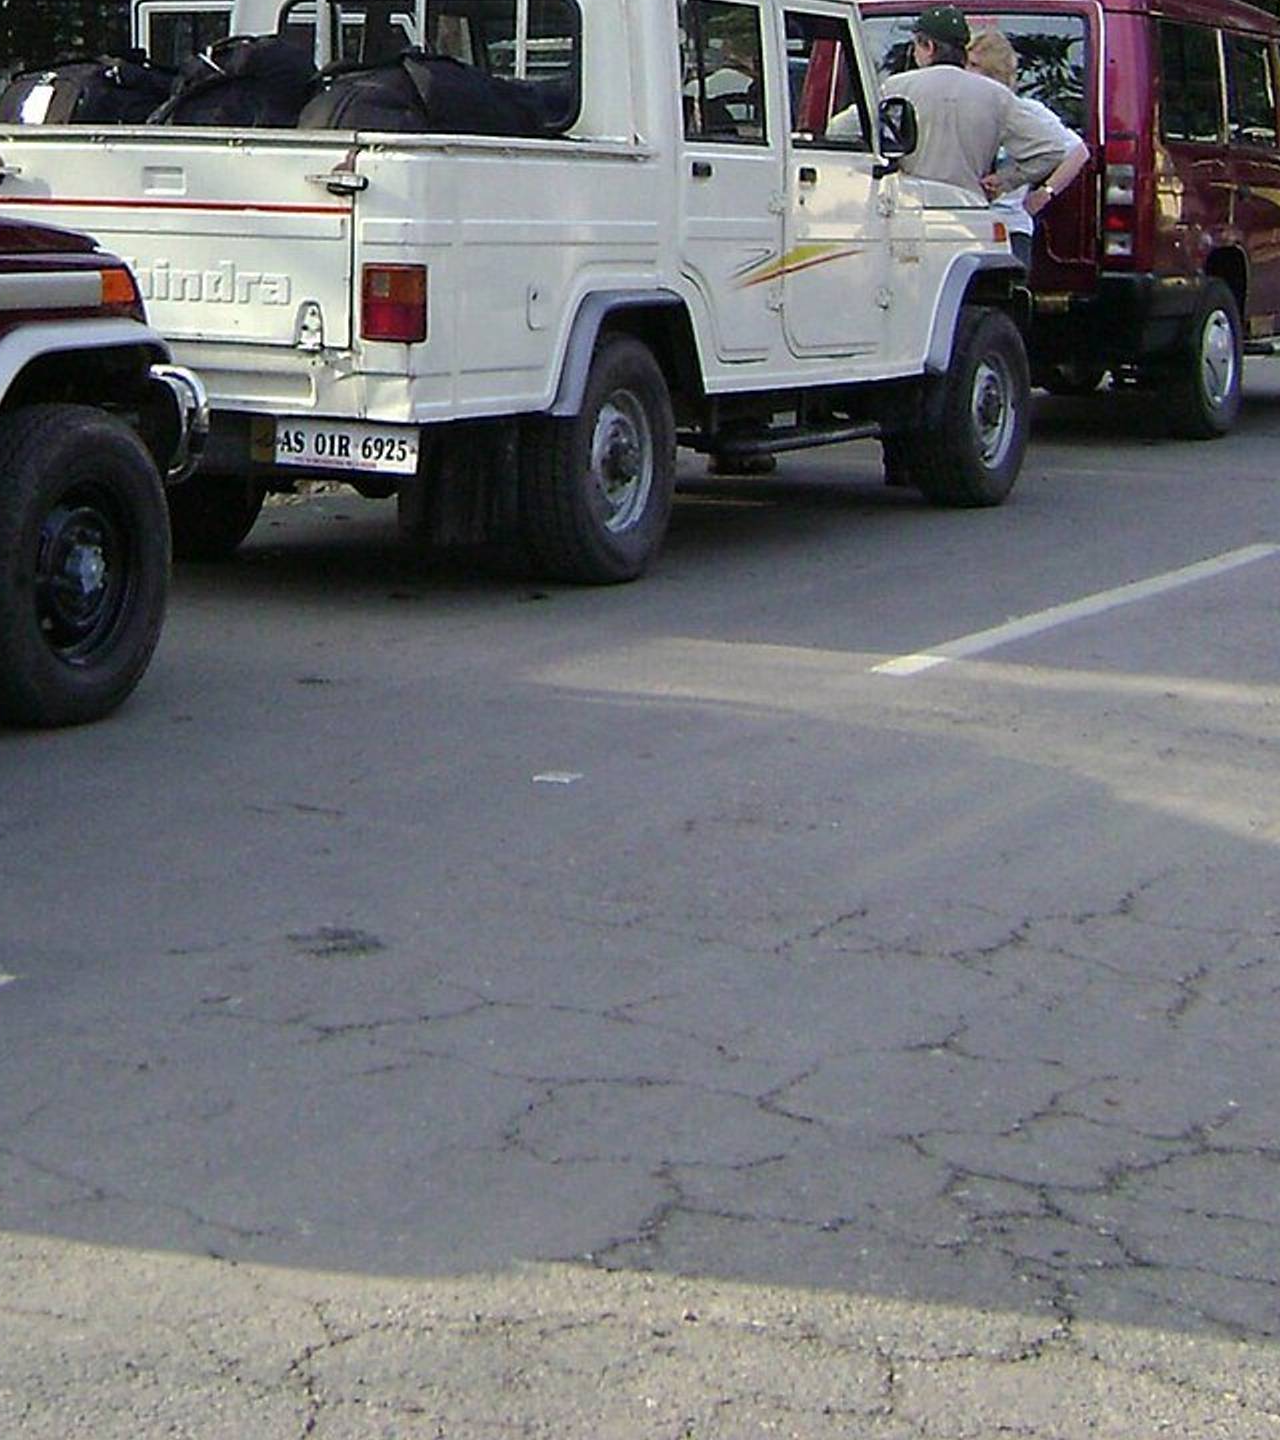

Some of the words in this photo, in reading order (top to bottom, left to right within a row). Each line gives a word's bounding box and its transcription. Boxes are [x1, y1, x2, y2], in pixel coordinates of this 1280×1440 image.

[280, 430, 305, 454] AS
[314, 433, 350, 458] 01R
[361, 436, 408, 462] 6925
